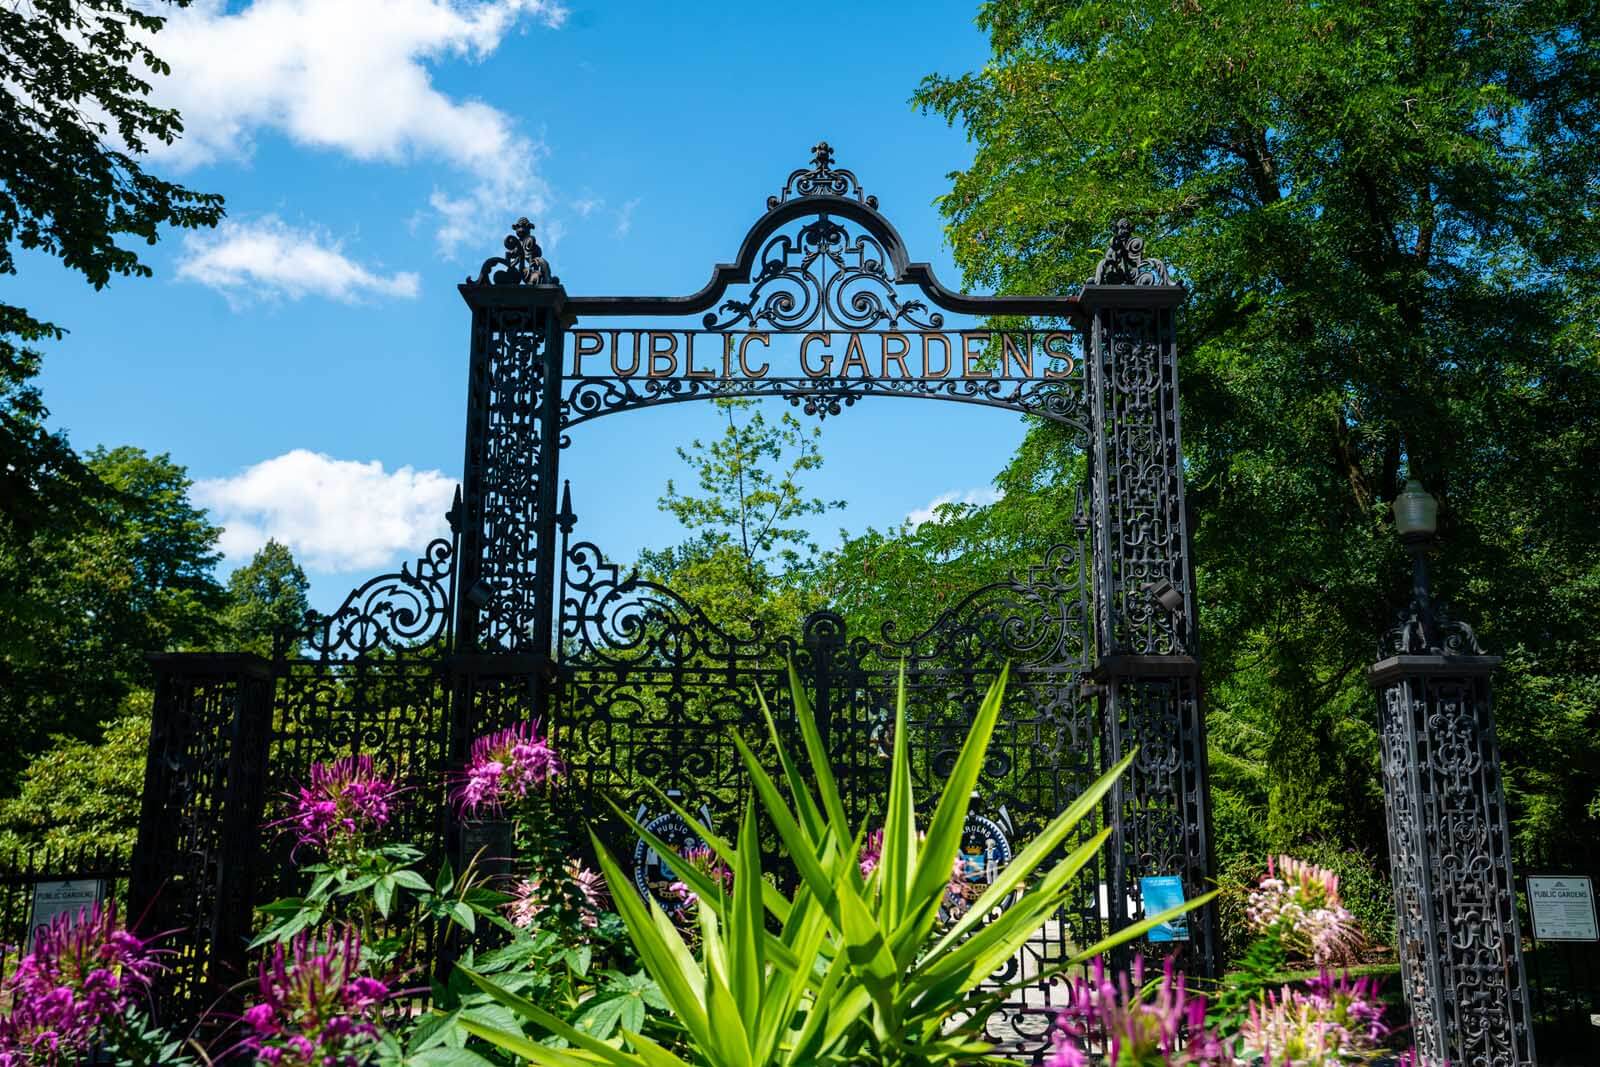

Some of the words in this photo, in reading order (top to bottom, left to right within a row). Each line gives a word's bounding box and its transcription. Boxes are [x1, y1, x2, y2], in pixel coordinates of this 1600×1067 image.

[574, 332, 770, 378] PUBLIC
[799, 332, 1075, 378] GARDENS
[656, 823, 688, 835] PUBLIC
[963, 825, 991, 838] RDENS
